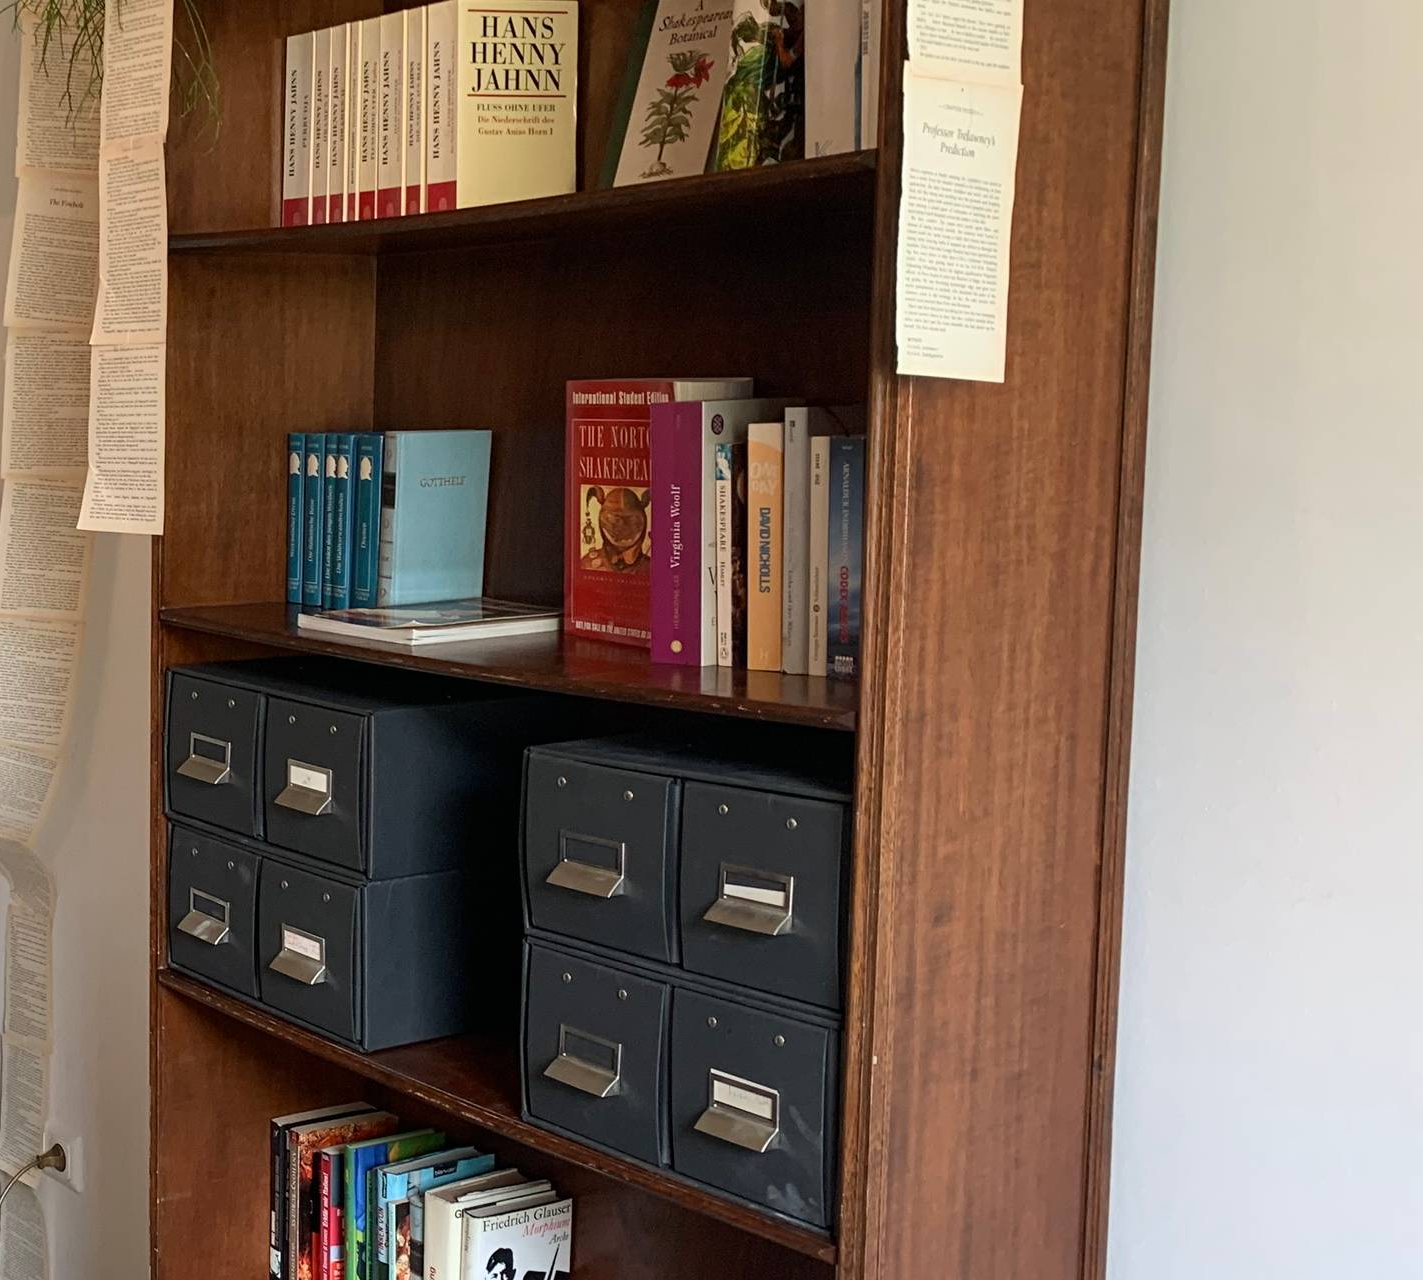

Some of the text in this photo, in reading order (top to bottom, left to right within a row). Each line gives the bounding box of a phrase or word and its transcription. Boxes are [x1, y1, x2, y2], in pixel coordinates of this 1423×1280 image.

[480, 15, 554, 40] HANS
[669, 24, 718, 45] Botanical
[433, 41, 441, 80] JAHNN
[469, 42, 566, 65] HENNY
[471, 68, 562, 92] JAHNN
[477, 103, 556, 112] FLUSS OHNE UFER
[477, 115, 555, 124] Die Niederschrift des
[478, 127, 503, 136] Gustav
[528, 128, 549, 136] Horn
[922, 121, 996, 149] Professor Trelawney's
[940, 141, 975, 158] Prediction
[49, 198, 61, 207] The
[572, 391, 669, 405] International Student Edition
[579, 425, 604, 448] THE
[578, 456, 650, 481] SHAKESPEA
[419, 475, 466, 488] GOTTHELF
[669, 484, 683, 568] Virginia Woolf
[719, 485, 727, 552] SHAKESPEARE
[759, 507, 770, 594] DAVID NICHOLLS
[592, 622, 601, 632] SALE
[289, 1151, 297, 1190] ANTHONY
[482, 1203, 571, 1233] Friedrich Glauser
[522, 1217, 570, 1239] Morphium
[548, 1232, 570, 1245] Arche
